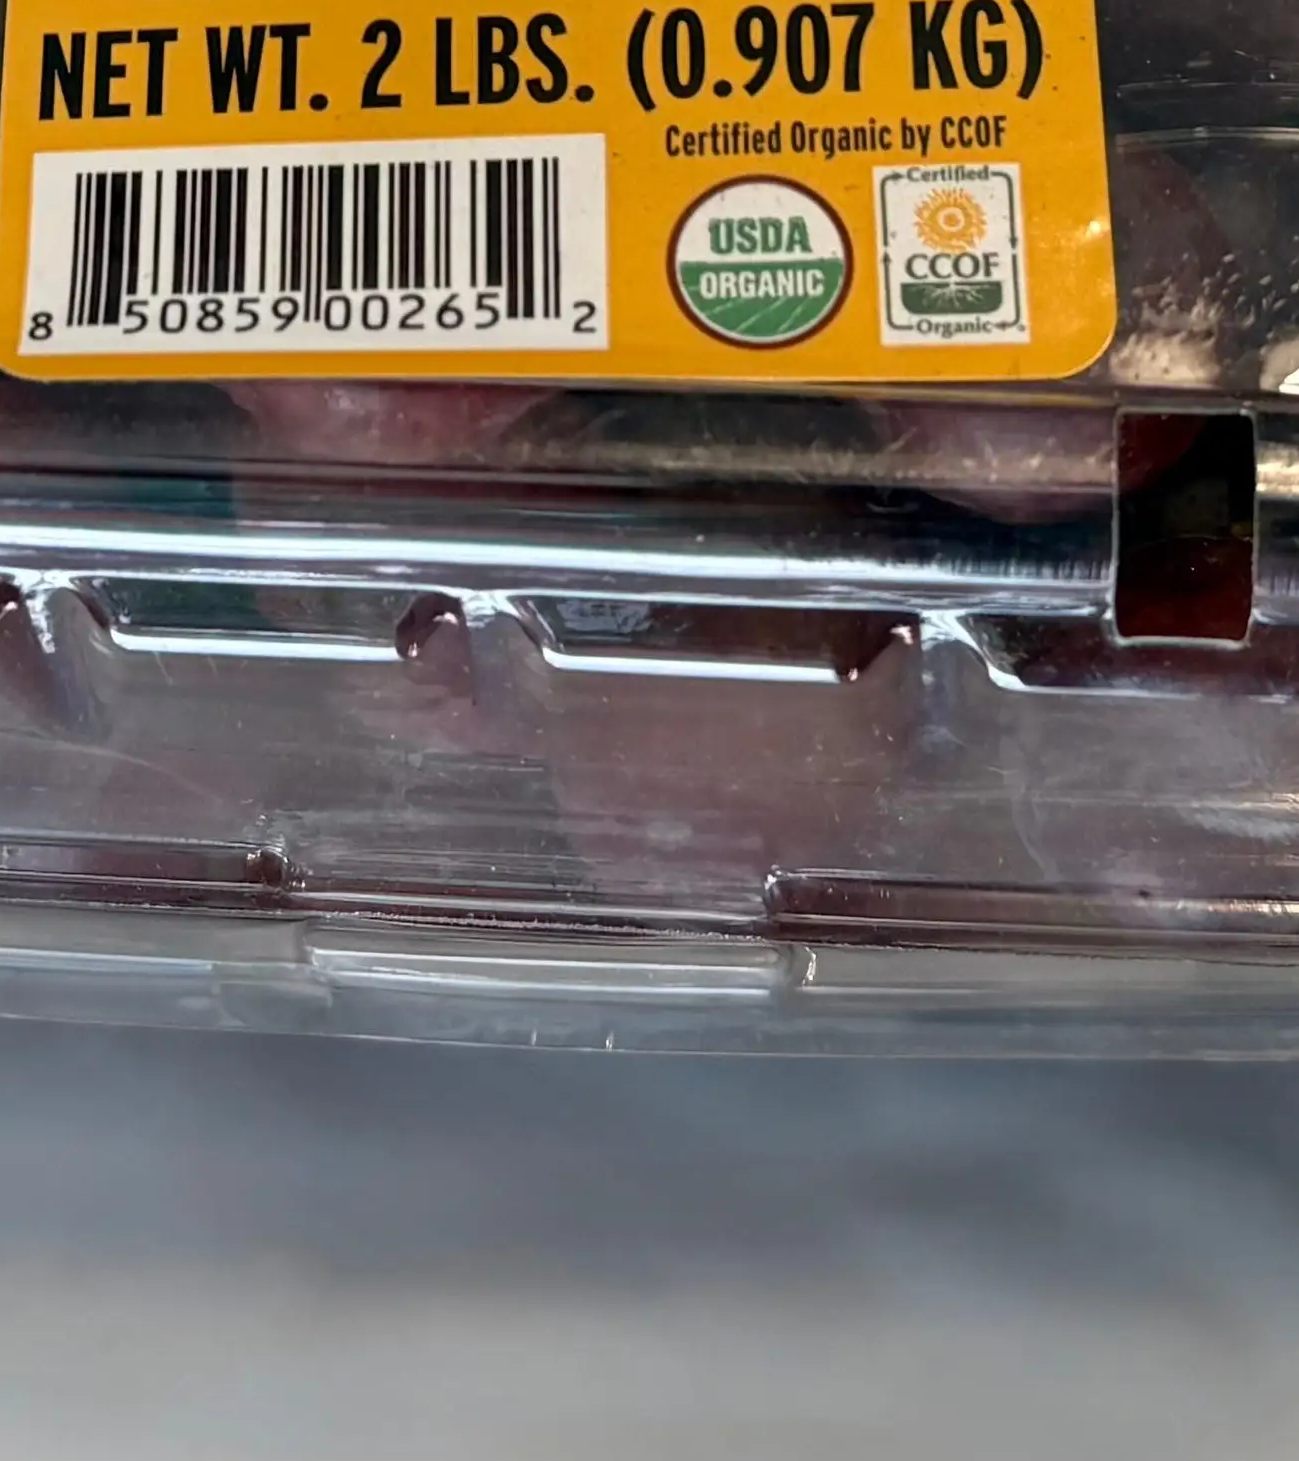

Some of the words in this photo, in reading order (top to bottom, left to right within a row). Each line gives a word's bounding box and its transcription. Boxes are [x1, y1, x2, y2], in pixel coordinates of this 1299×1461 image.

[38, 27, 178, 121] NET
[204, 22, 329, 114] WT.
[360, 18, 403, 110] 2
[434, 13, 595, 107] LBS.
[627, 2, 876, 112] (0.907
[664, 120, 783, 158] Certified
[790, 118, 893, 160] Organic
[901, 118, 932, 156] by
[940, 114, 1008, 150] CCOF
[905, 163, 991, 184] Certified
[707, 214, 814, 256] USDA
[698, 267, 825, 300] ORGANIC
[904, 251, 1001, 280] CCOF
[28, 311, 54, 340] 8
[122, 296, 301, 334] 50859
[324, 292, 501, 331] 00265
[572, 302, 598, 333] 2
[915, 314, 994, 339] Organic
